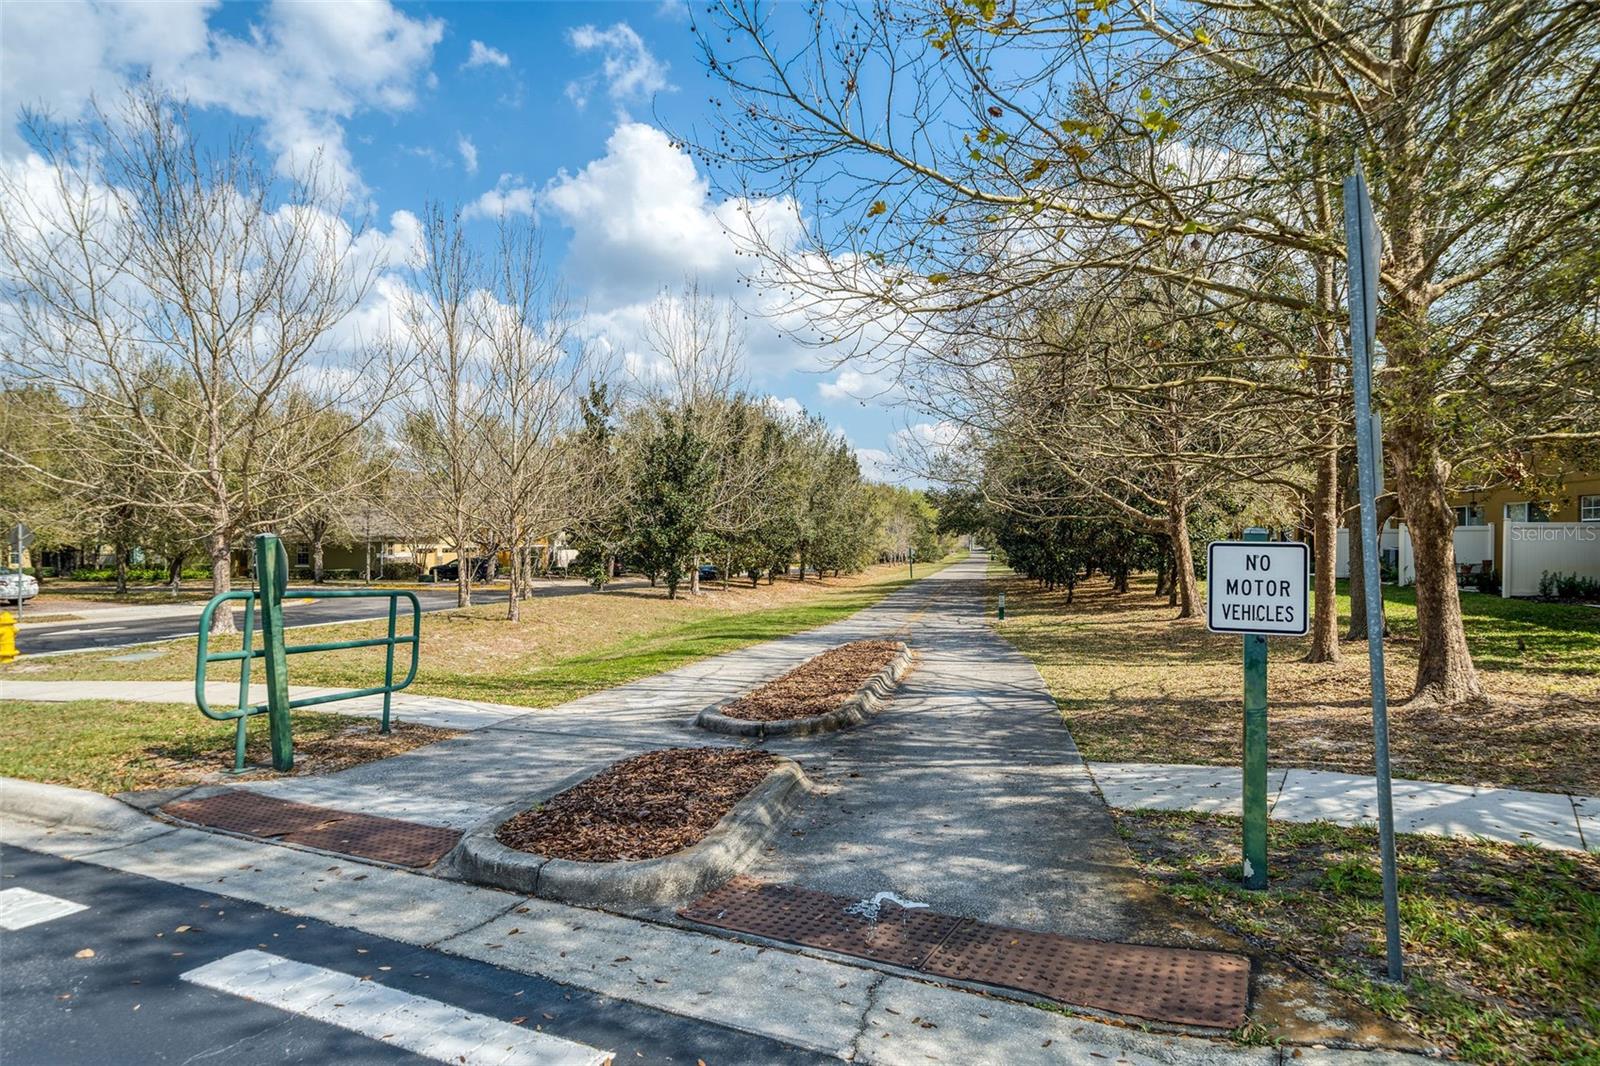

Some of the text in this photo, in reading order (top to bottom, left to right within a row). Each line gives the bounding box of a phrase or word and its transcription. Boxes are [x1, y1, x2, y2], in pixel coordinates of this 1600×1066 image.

[1246, 554, 1271, 571] NO
[1226, 579, 1290, 597] MOTOR
[1222, 603, 1294, 623] VEHICLES
